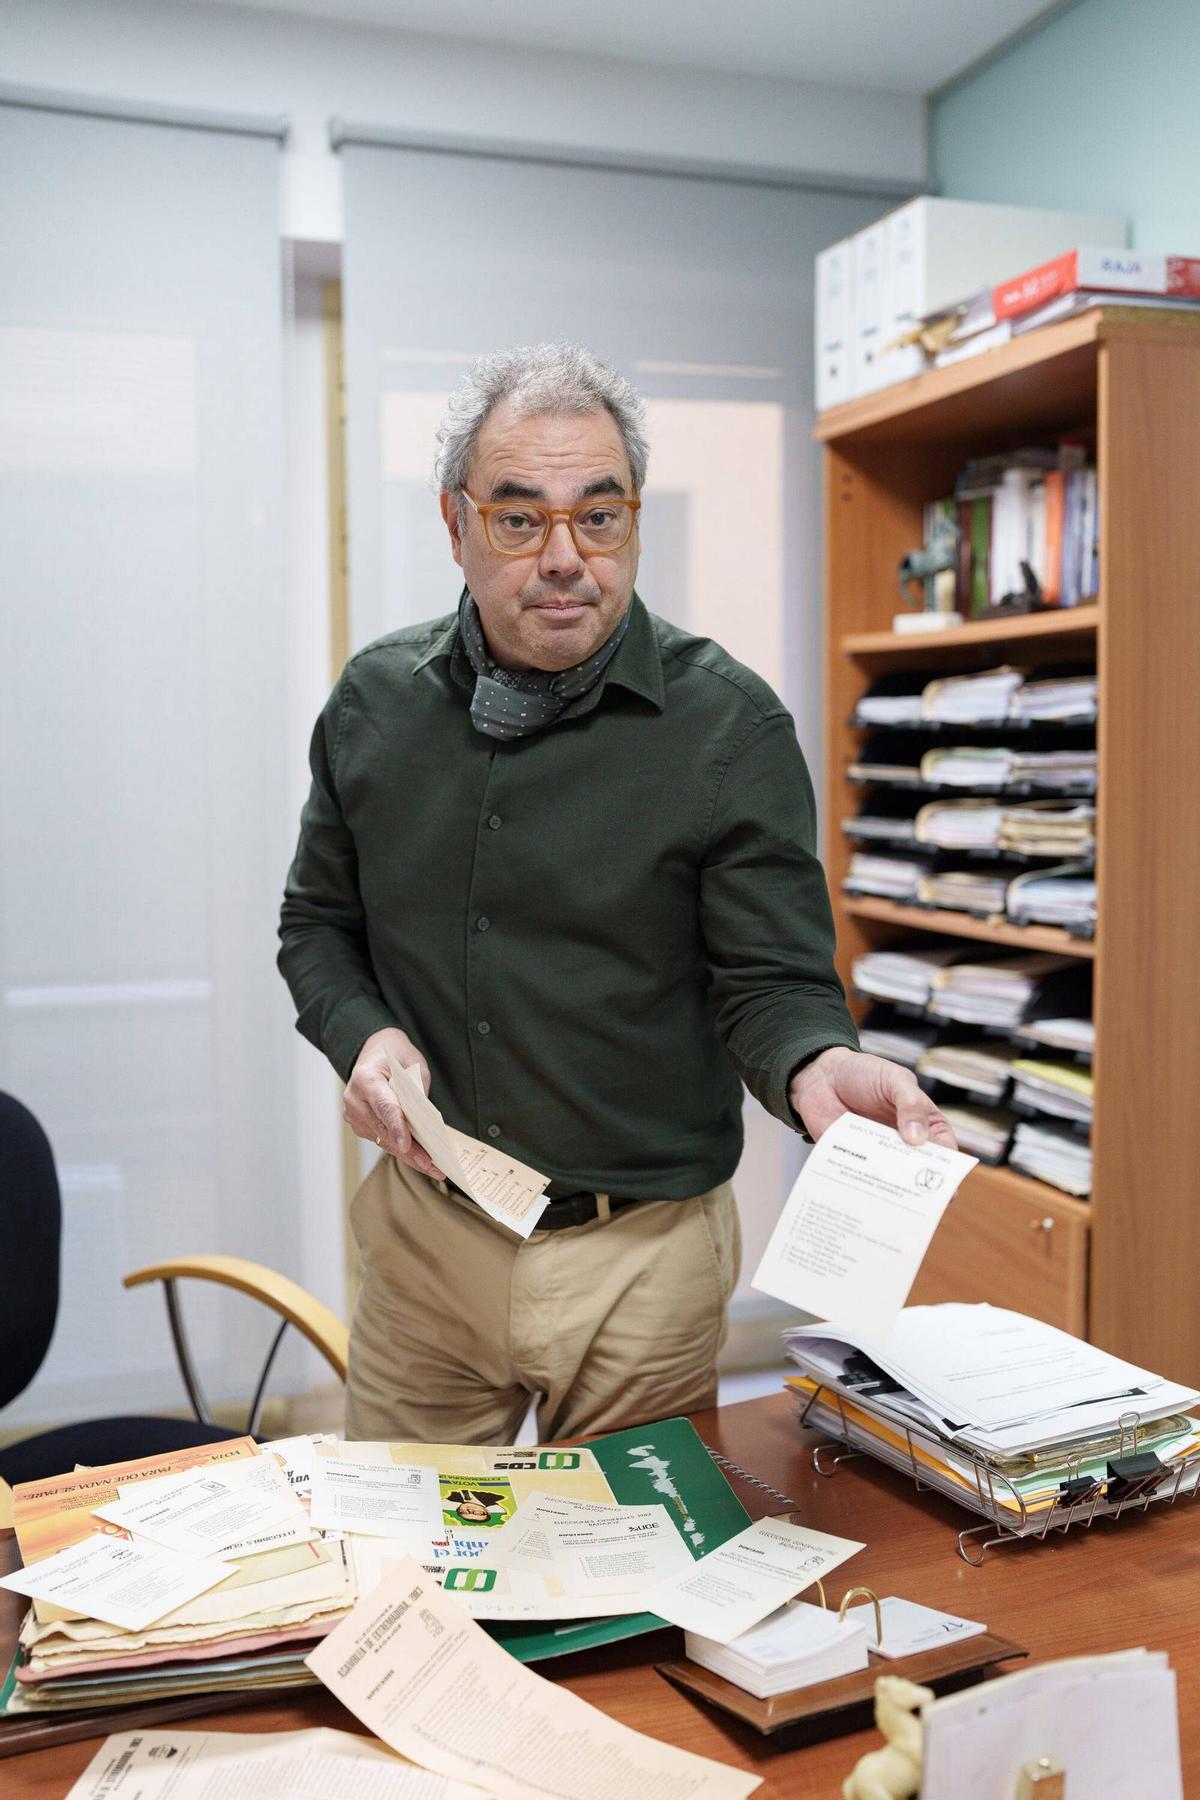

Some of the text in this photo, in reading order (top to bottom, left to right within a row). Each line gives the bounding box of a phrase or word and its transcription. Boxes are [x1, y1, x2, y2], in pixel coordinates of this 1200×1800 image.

[211, 1450, 241, 1460] VOTA
[493, 1462, 537, 1470] CDS
[141, 1466, 172, 1477] PARA
[114, 1472, 139, 1483] QUE
[287, 1474, 310, 1484] VOT
[79, 1478, 112, 1489] NADA
[58, 1485, 76, 1493] SE
